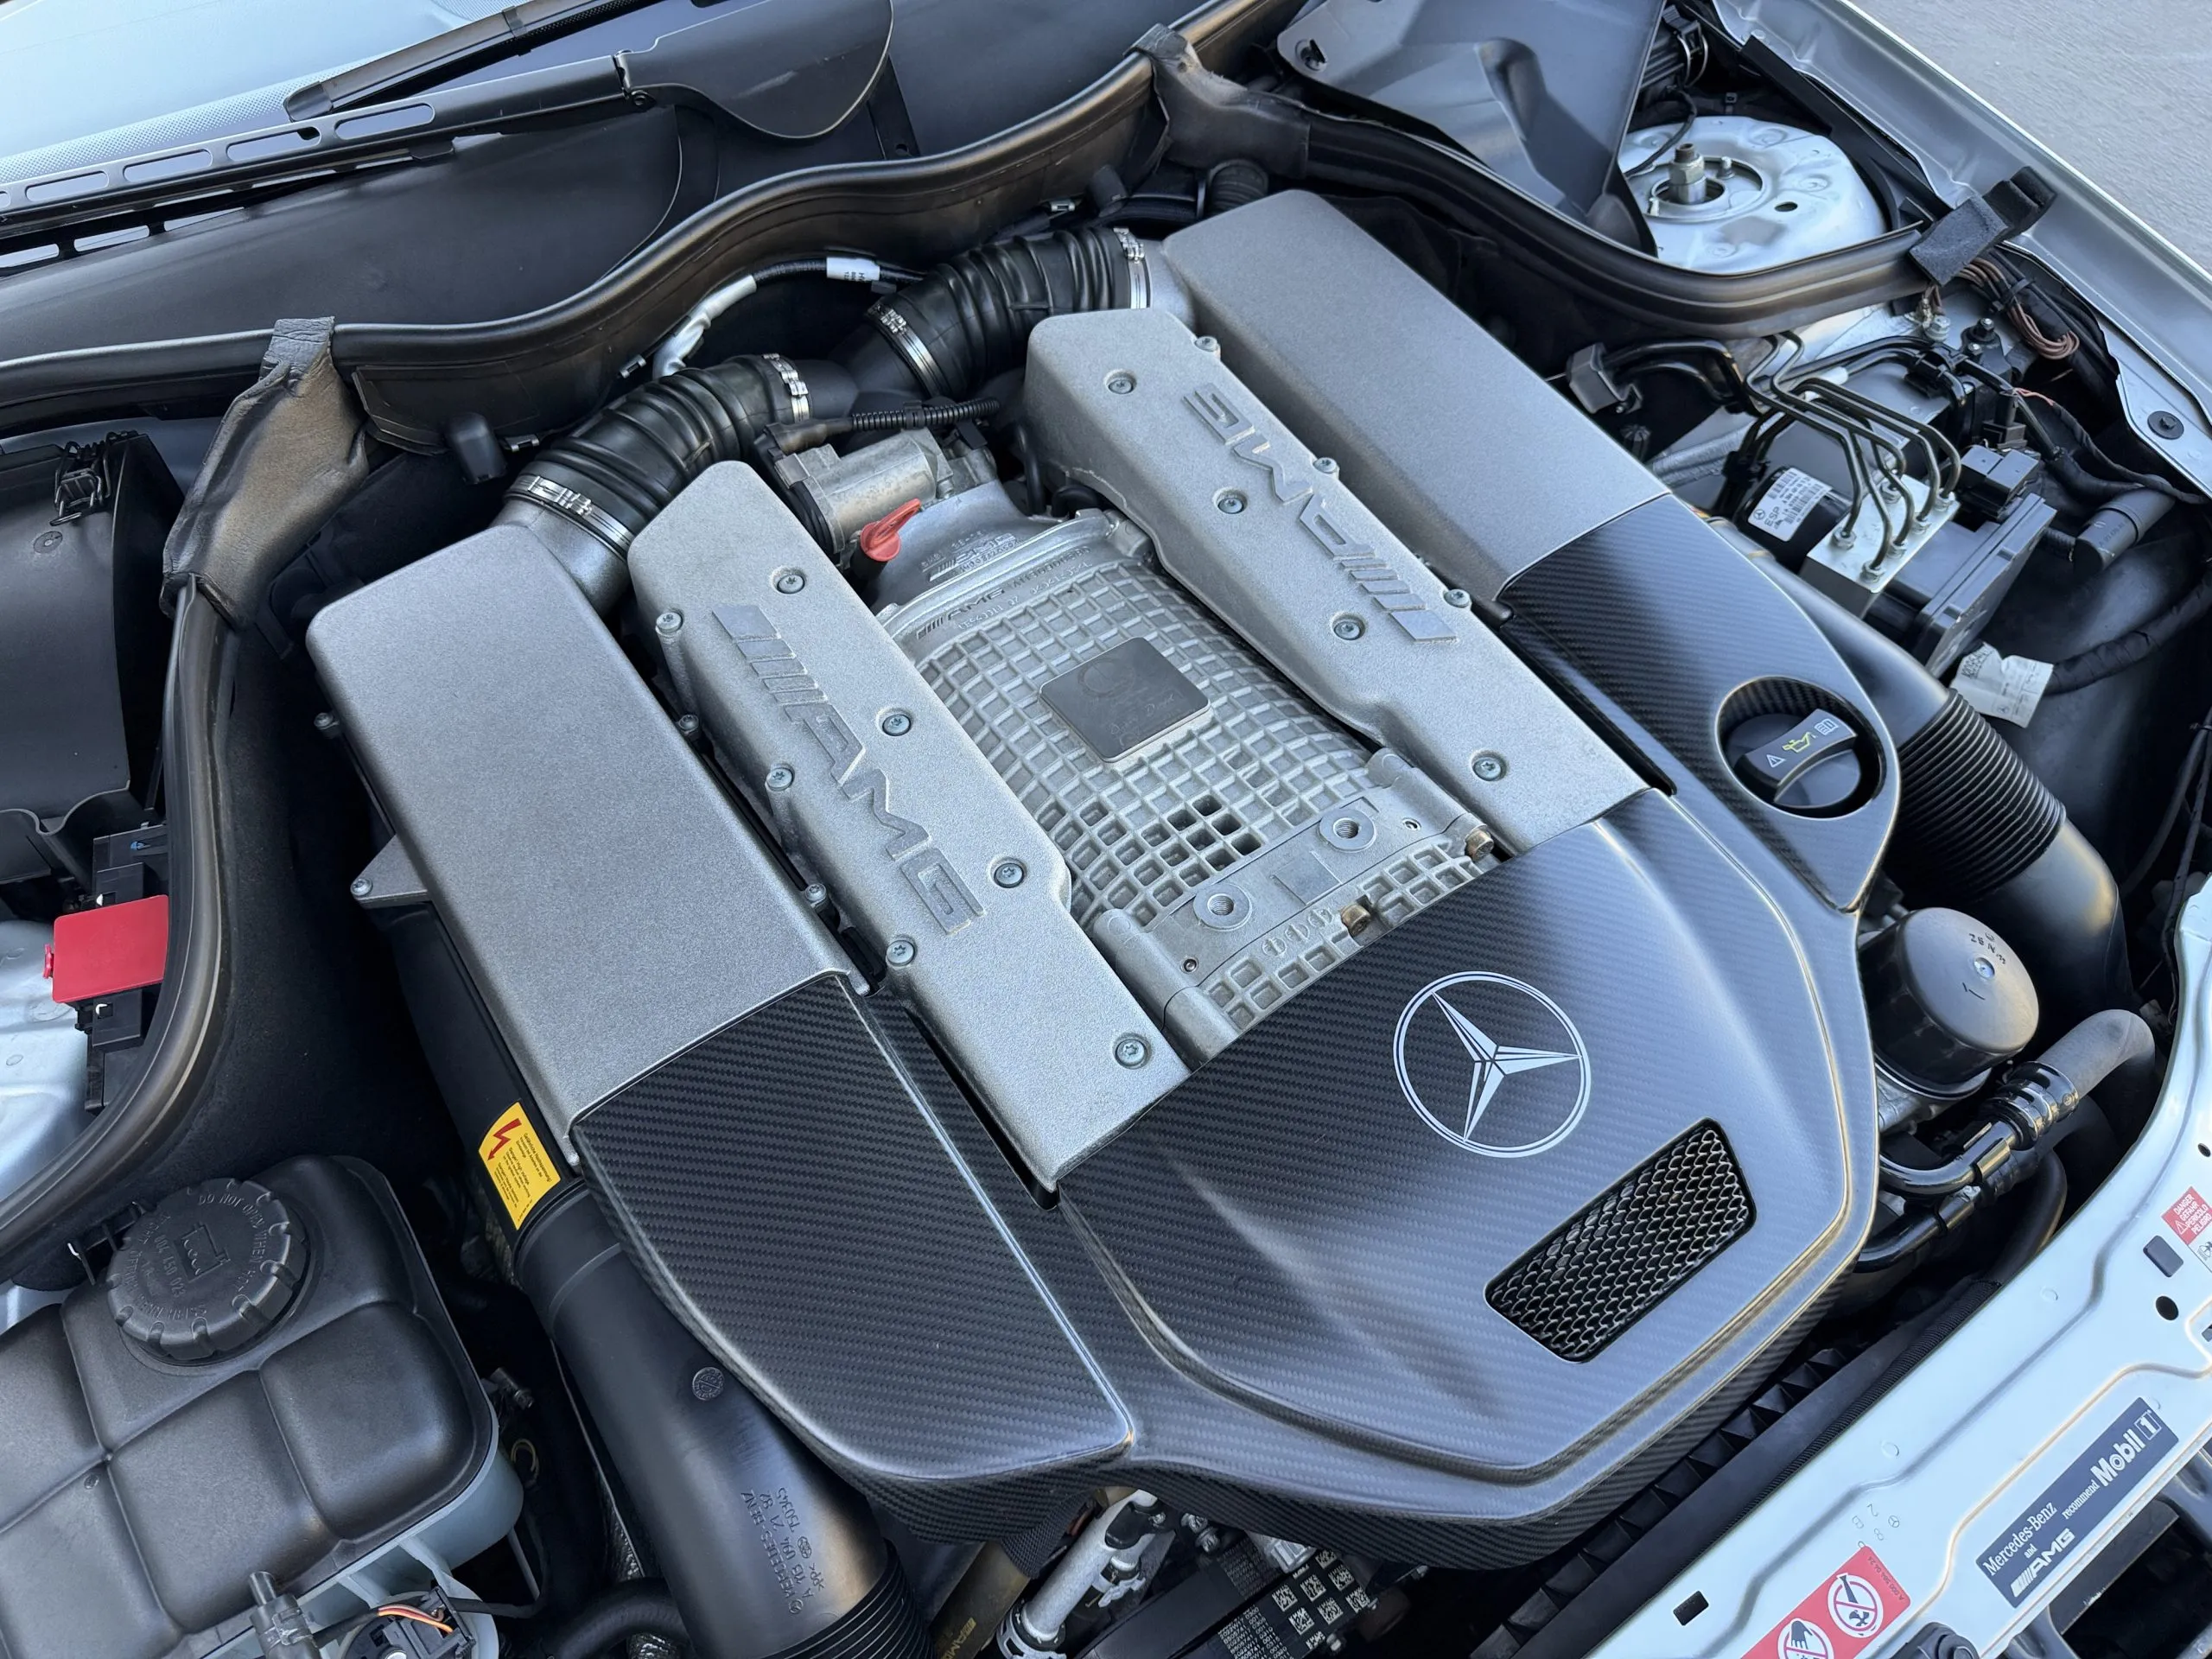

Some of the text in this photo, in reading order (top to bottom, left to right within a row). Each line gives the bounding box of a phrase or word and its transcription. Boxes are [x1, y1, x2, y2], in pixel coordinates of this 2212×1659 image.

[1181, 382, 1376, 562] AMG
[1763, 505, 1782, 527] ESP
[785, 703, 987, 937] AMG
[198, 1195, 214, 1205] DO
[219, 1192, 245, 1208] NOT
[2173, 1194, 2195, 1215] DANGER
[243, 1204, 265, 1230] OPEN
[2179, 1201, 2200, 1222] GEFAHR
[2185, 1205, 2209, 1228] PERICOLO
[2191, 1214, 2212, 1235] PELIGRO
[251, 1230, 269, 1263] WHEN
[2062, 1481, 2101, 1519] recommend
[2090, 1429, 2145, 1487] Mobil
[774, 1485, 802, 1532] 750345
[768, 1513, 785, 1531] 21
[740, 1488, 797, 1599] MERCEDES-BENZ
[778, 1535, 798, 1560] 094
[1982, 1502, 2057, 1576] Mercedes-Benz
[2024, 1545, 2037, 1559] and
[2029, 1529, 2075, 1579] AMG
[789, 1562, 808, 1585] 113
[799, 1586, 814, 1599] A
[1887, 1583, 1899, 1596] 000
[1218, 1617, 1245, 1640] 2022W17
[1243, 1605, 1260, 1620] 0300
[1247, 1611, 1262, 1625] 0011
[1254, 1621, 1270, 1635] 0011
[1225, 1627, 1252, 1649] 2022W17
[1258, 1625, 1274, 1640] 0310
[1262, 1630, 1277, 1645] 0011
[1268, 1641, 1284, 1655] 0011
